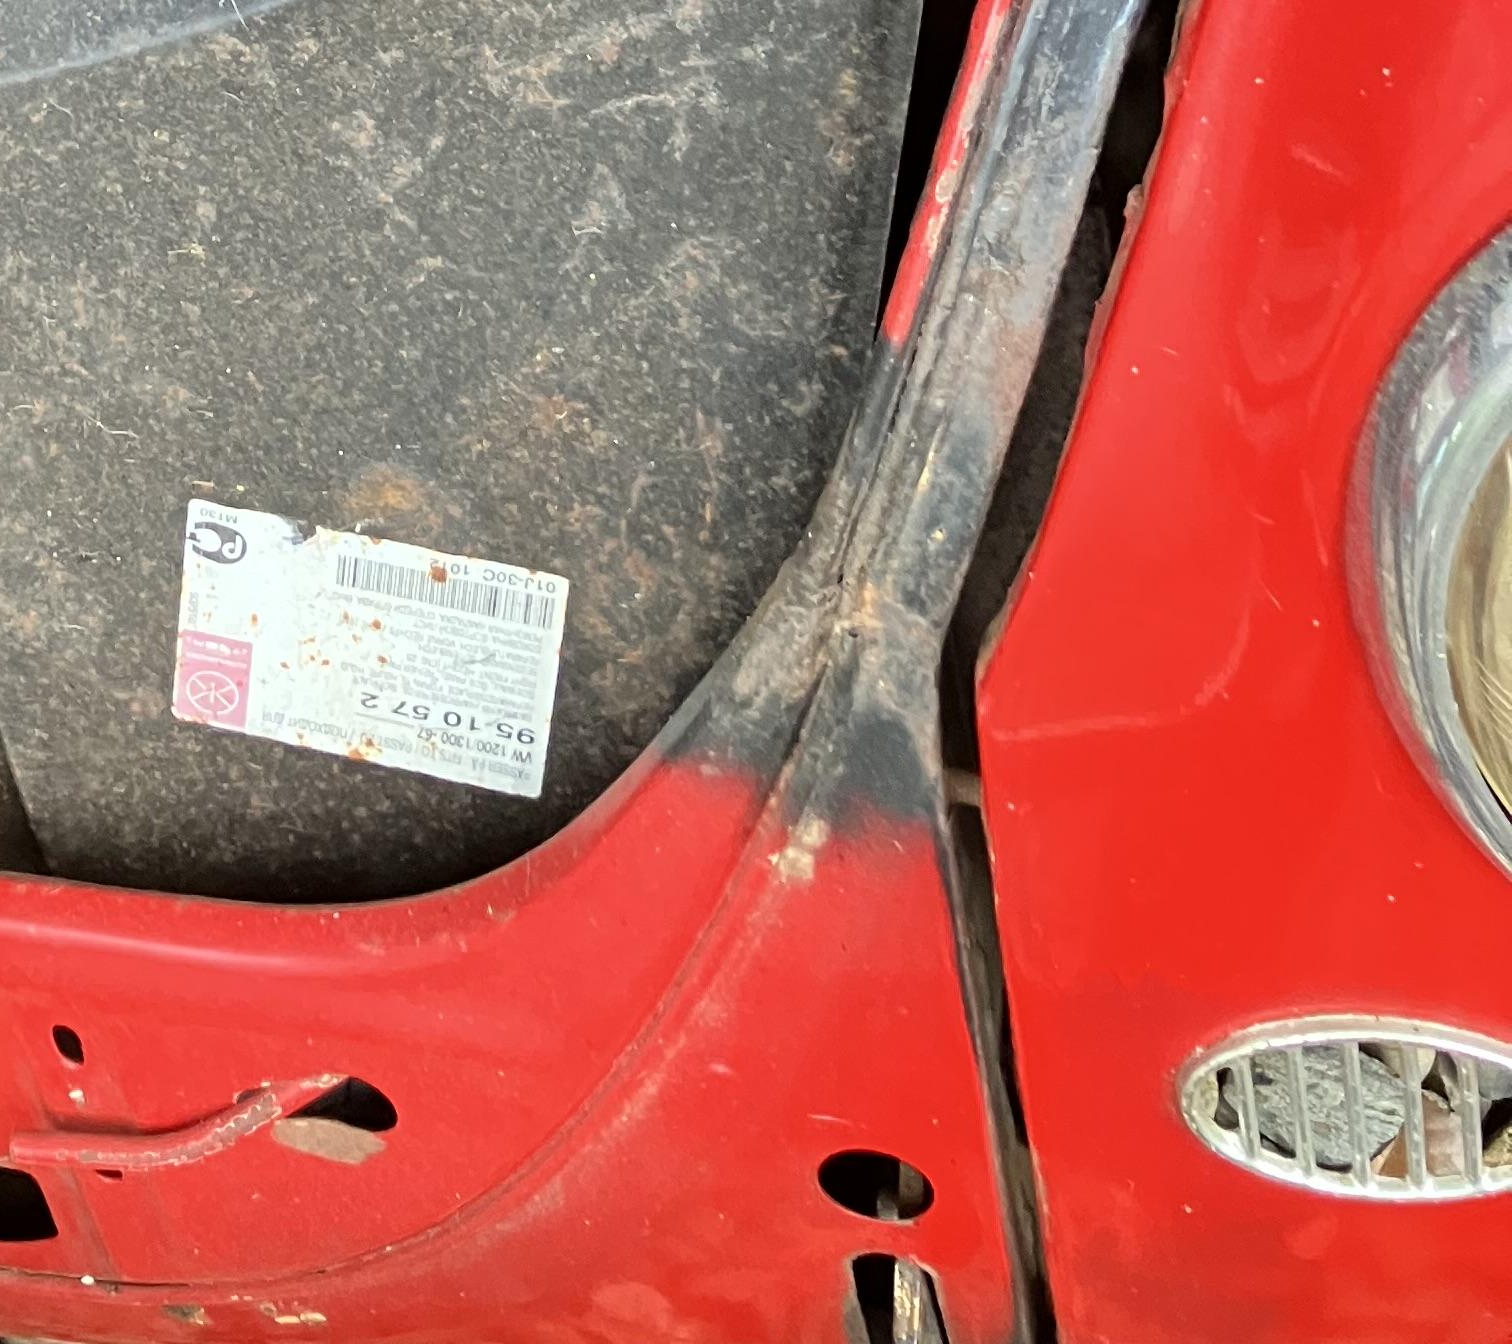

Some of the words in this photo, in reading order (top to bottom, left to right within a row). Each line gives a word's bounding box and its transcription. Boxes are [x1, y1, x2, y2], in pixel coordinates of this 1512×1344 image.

[482, 567, 556, 596] 01J-30C
[358, 690, 379, 710] 2
[390, 697, 430, 722] 57
[442, 709, 481, 732] 10
[415, 725, 437, 742] -67
[494, 720, 536, 746] 95
[510, 746, 532, 764] VW
